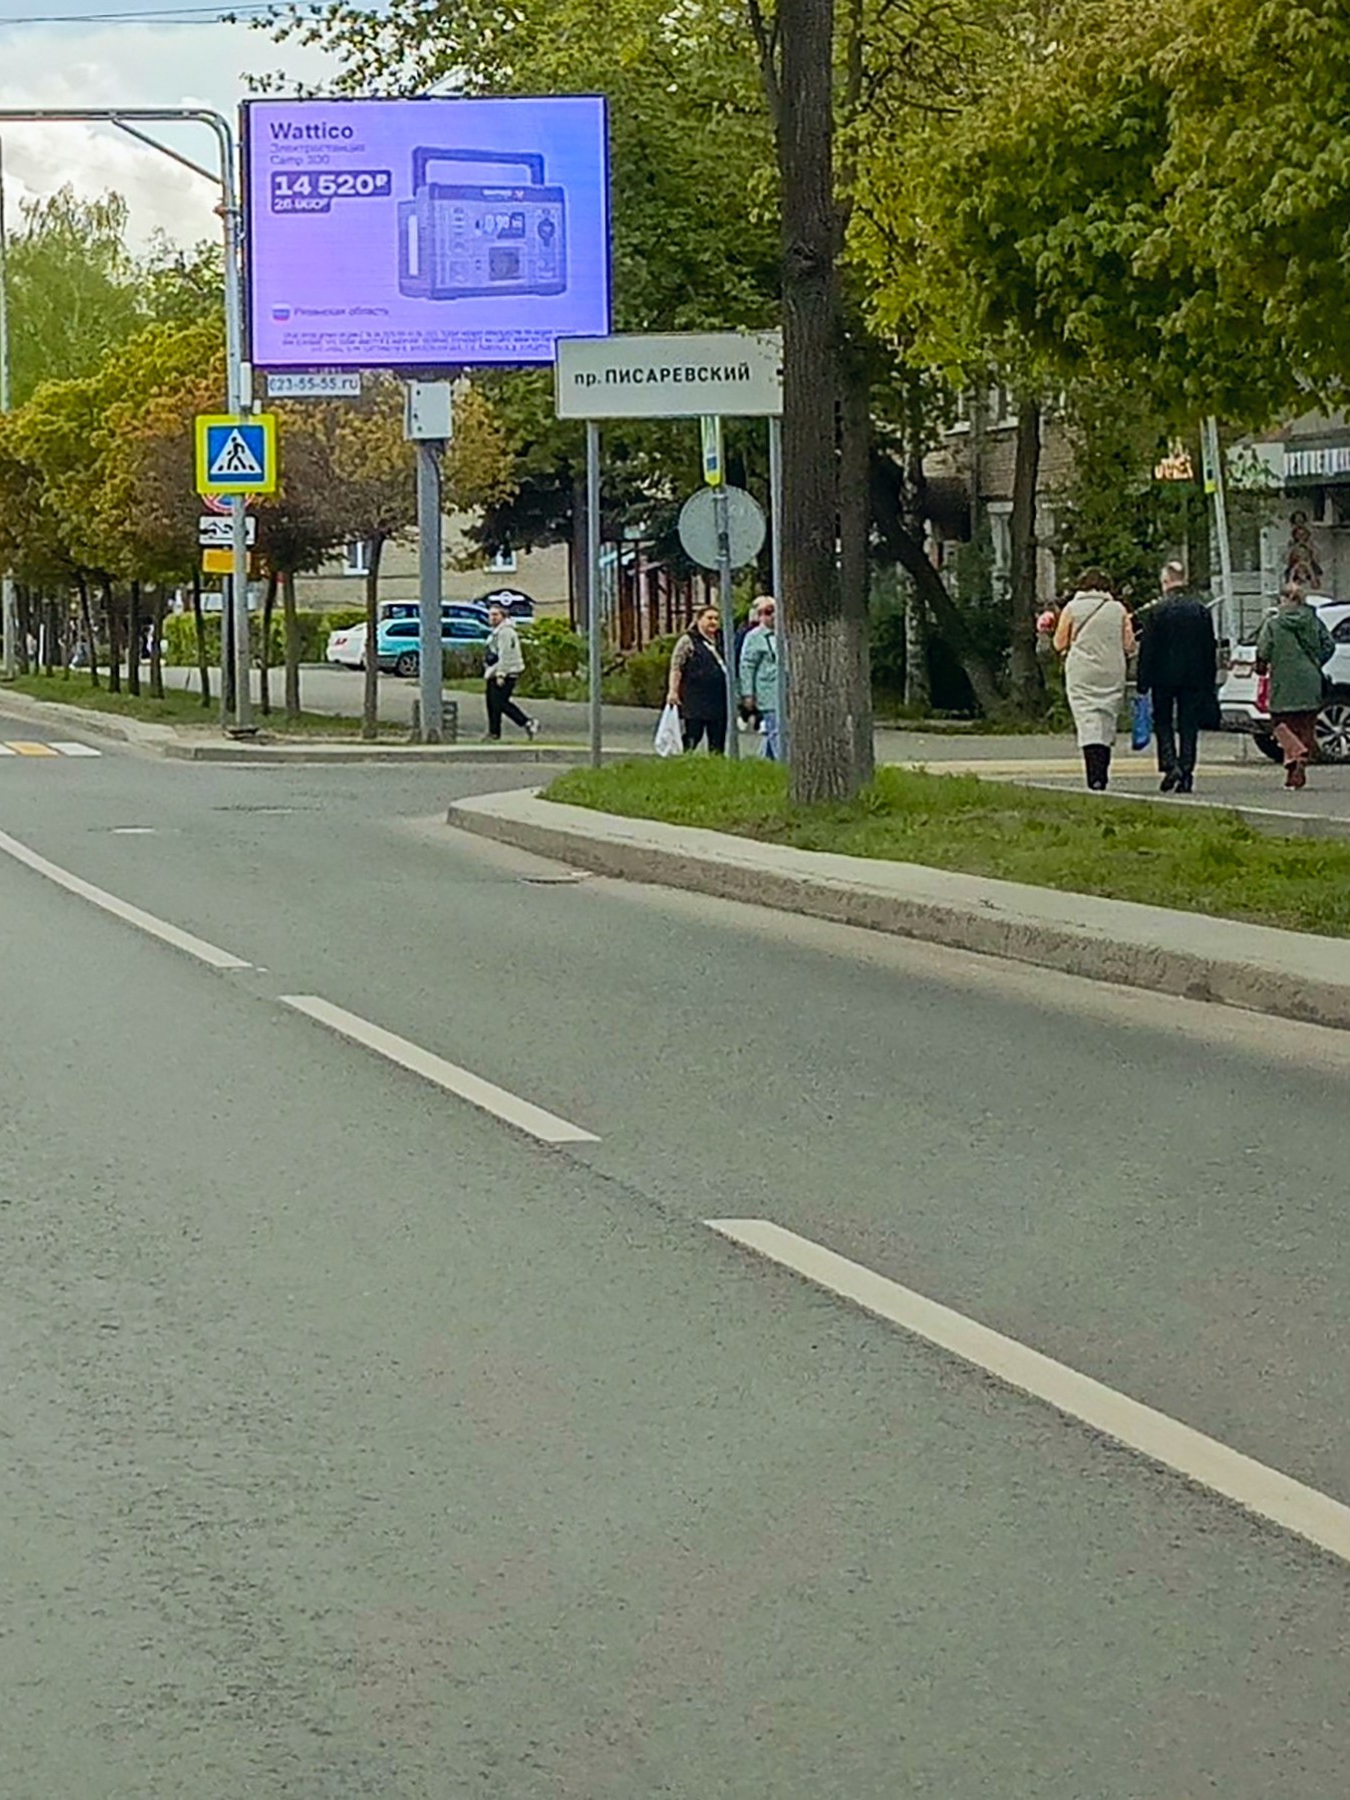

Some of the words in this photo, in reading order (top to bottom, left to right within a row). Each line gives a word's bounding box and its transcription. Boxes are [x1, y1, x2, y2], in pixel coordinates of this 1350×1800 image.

[270, 121, 354, 140] Wattico
[274, 175, 312, 196] 14
[605, 362, 750, 384] ПИСАРЕВСКИЙ
